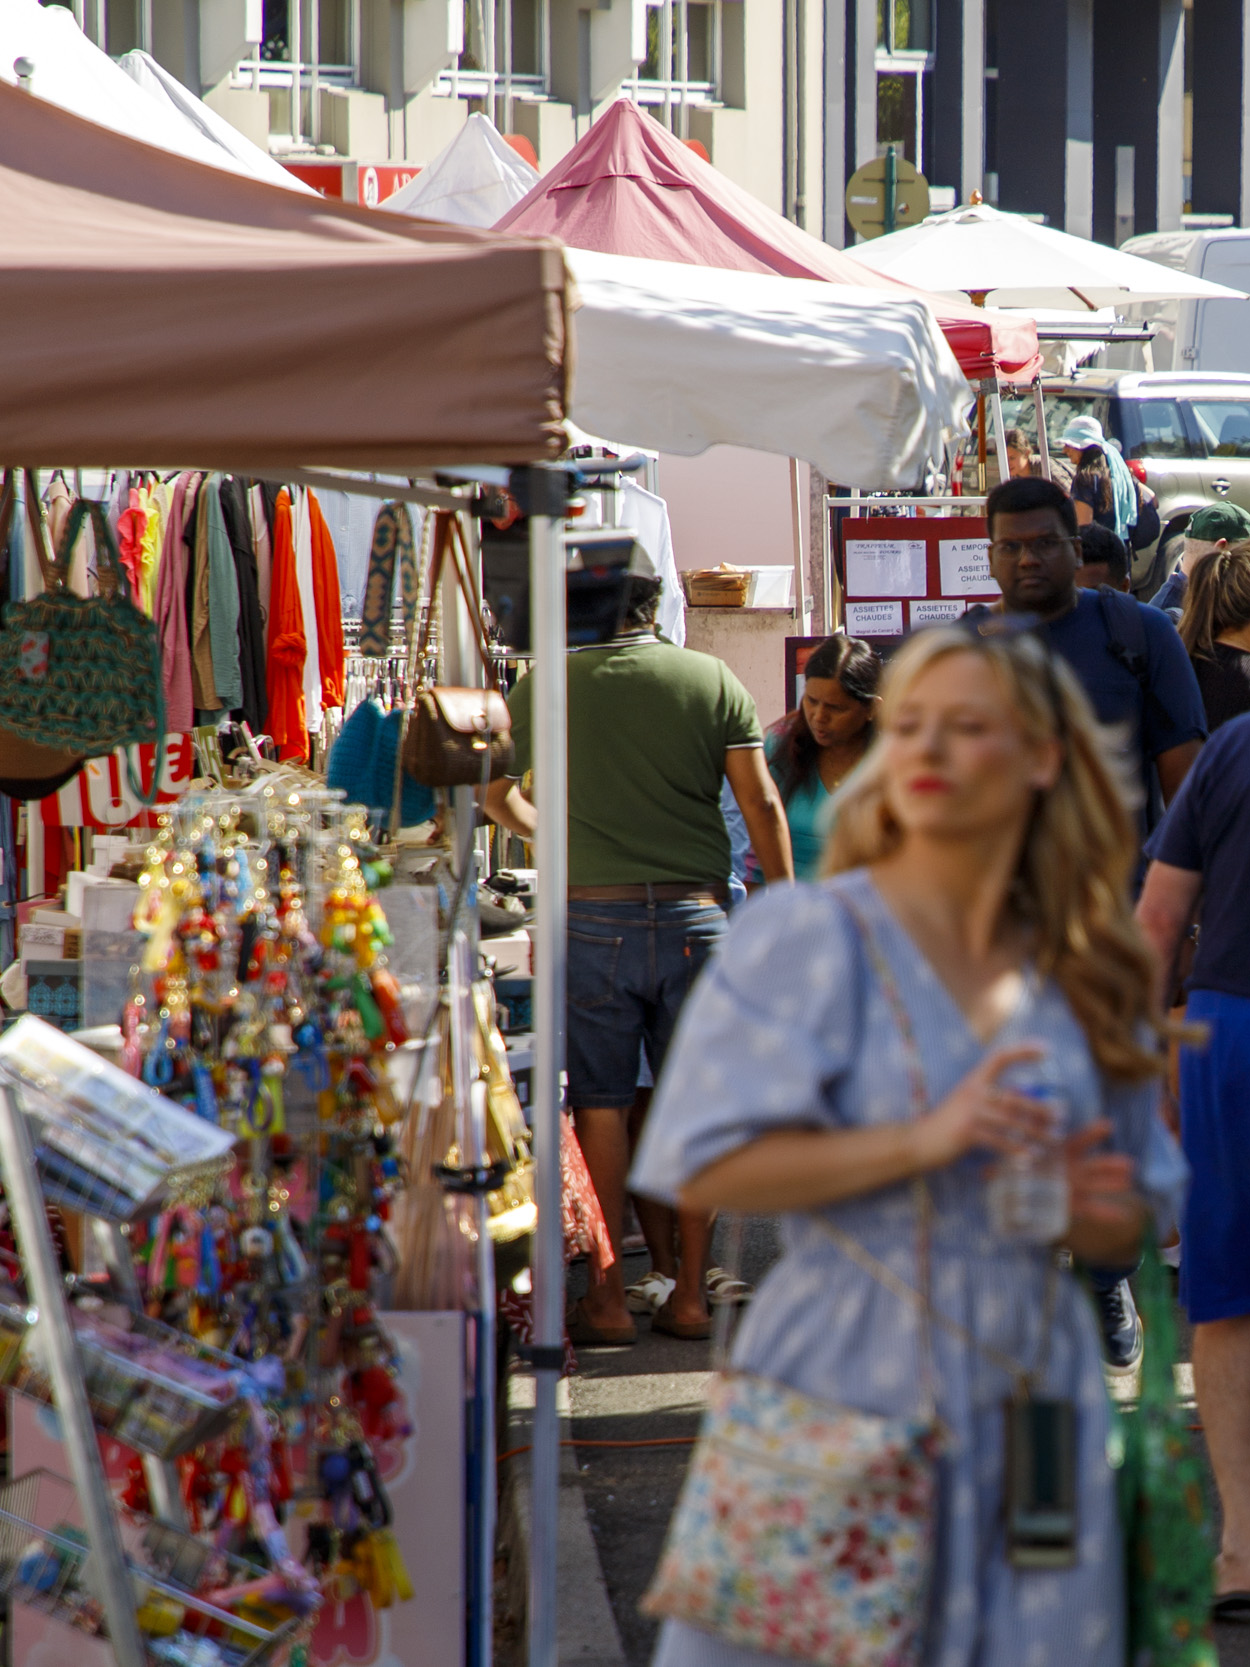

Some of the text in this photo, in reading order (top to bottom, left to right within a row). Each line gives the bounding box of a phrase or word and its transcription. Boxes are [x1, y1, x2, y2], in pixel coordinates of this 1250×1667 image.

[958, 564, 989, 572] ASSIETT
[853, 604, 894, 613] ASSIETTES
[916, 604, 958, 612] ASSIETTES
[856, 613, 892, 621] CHAUDES
[918, 613, 956, 621] CHAUDES
